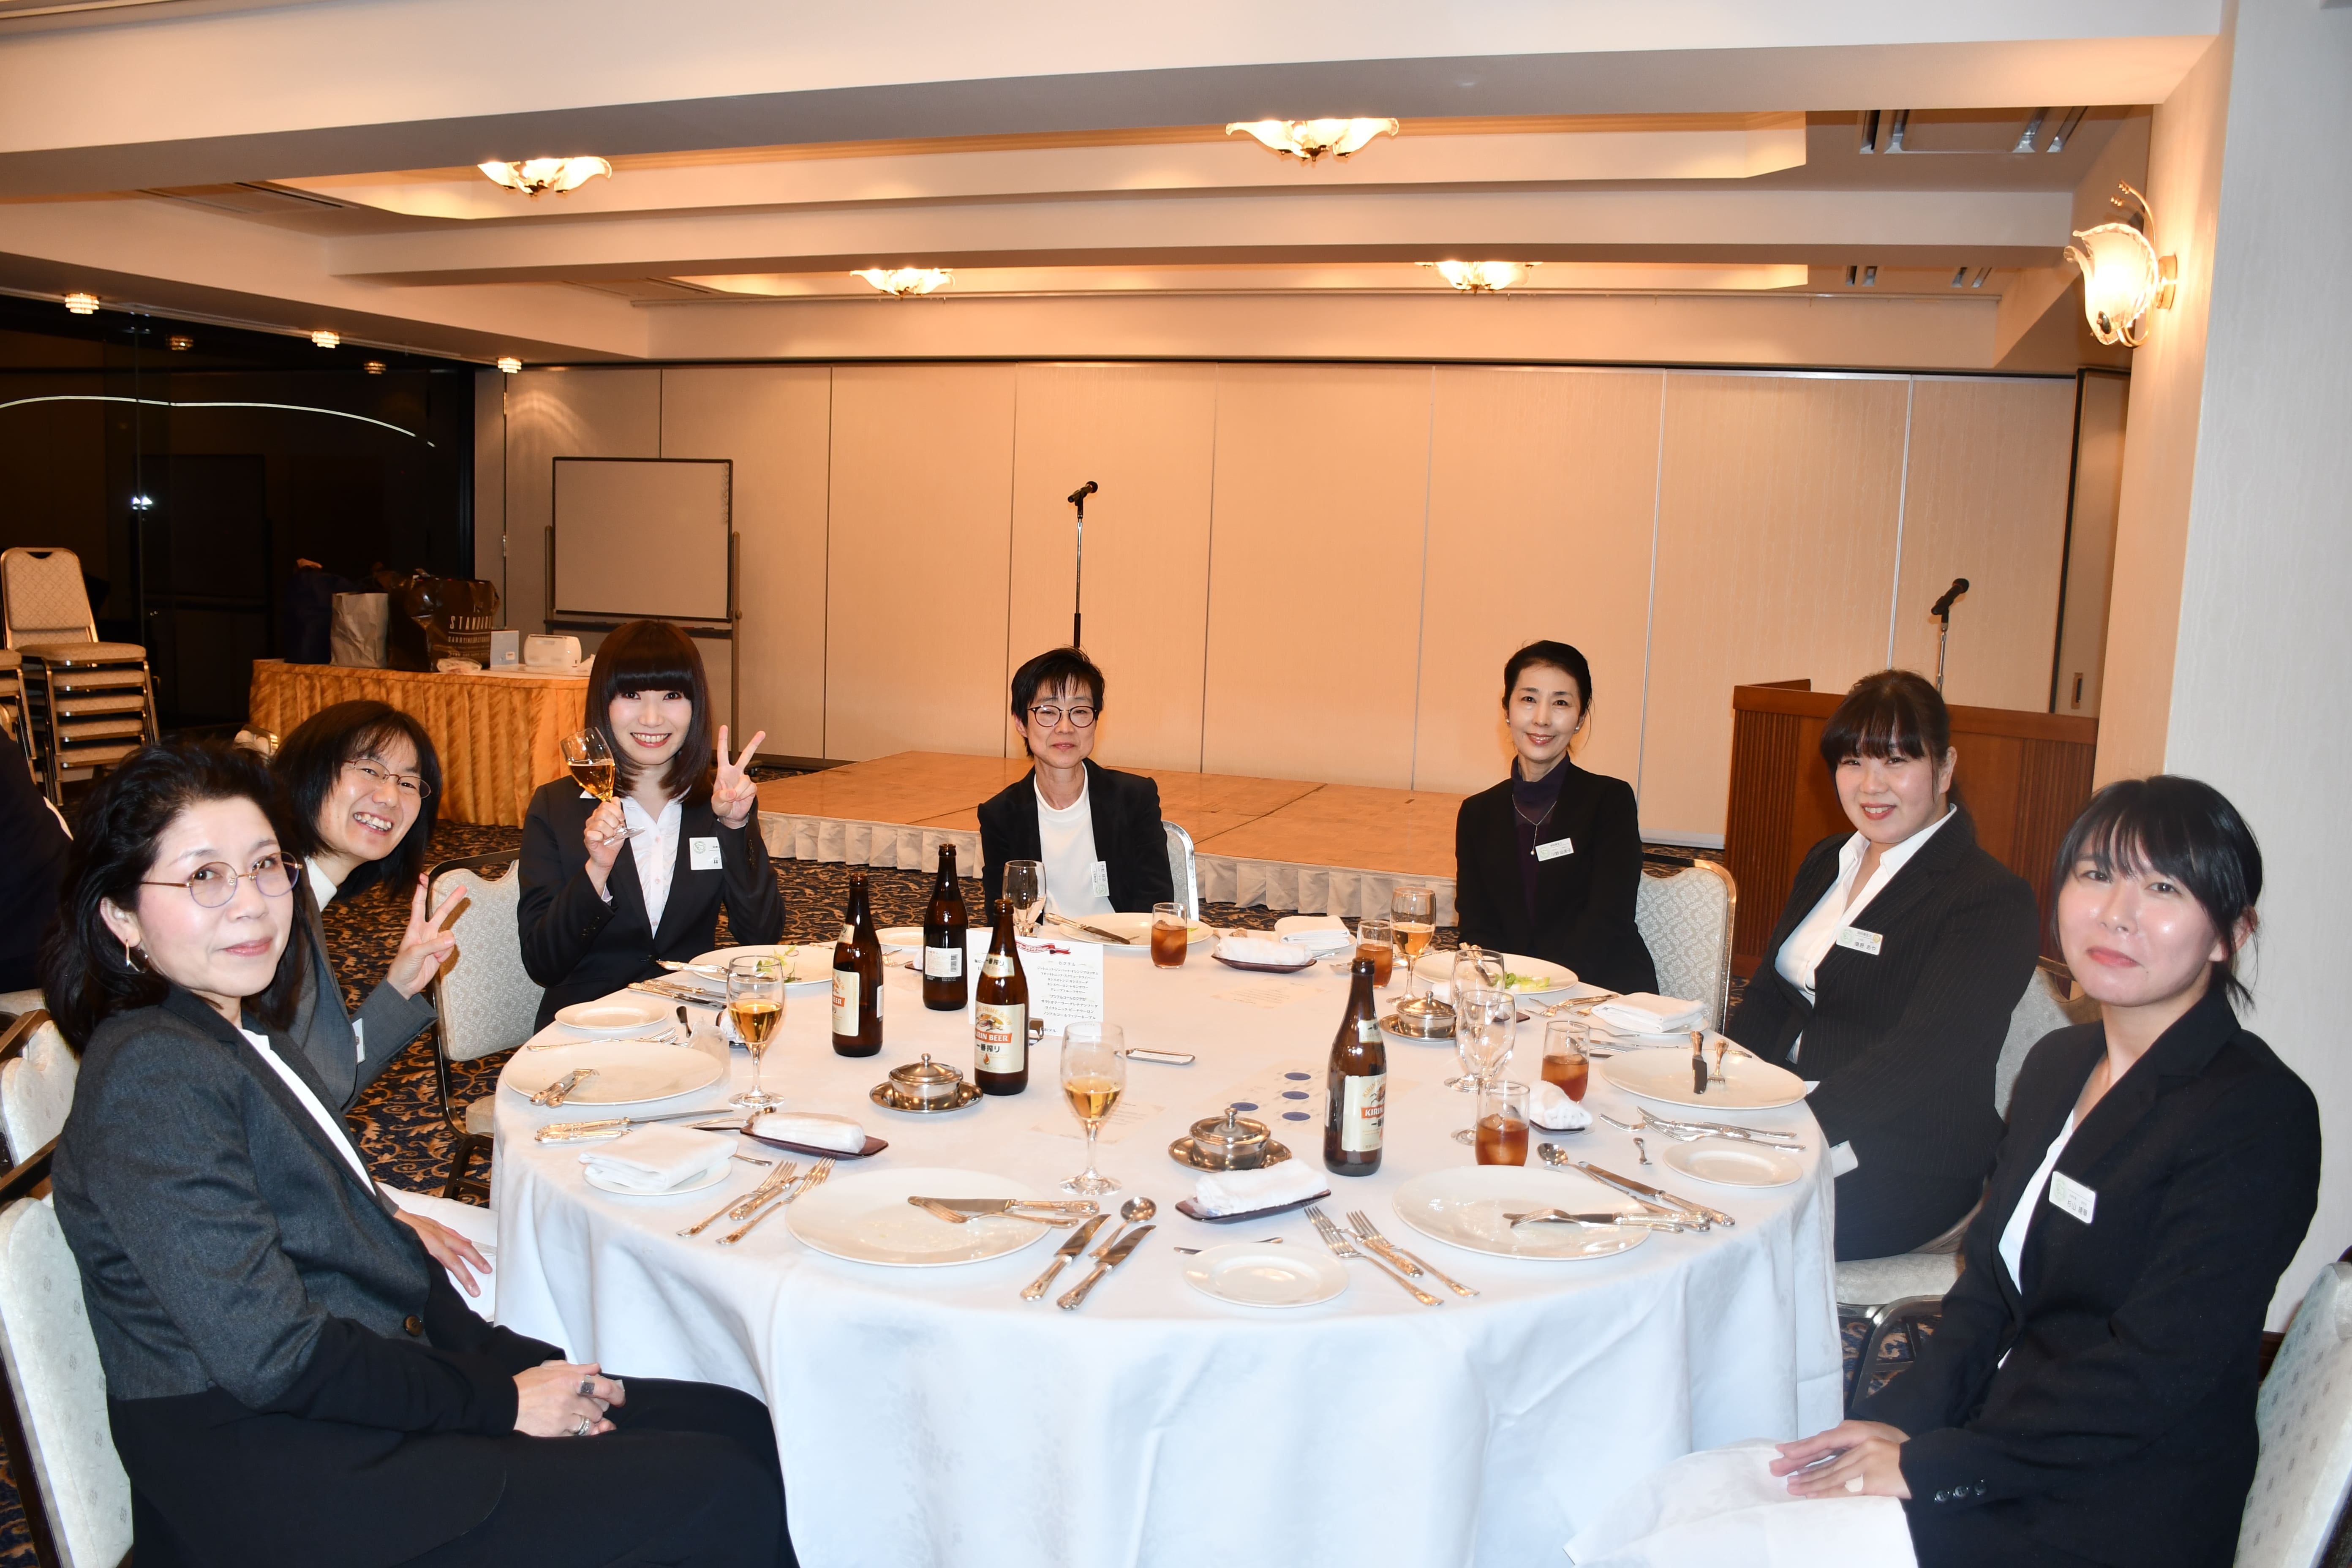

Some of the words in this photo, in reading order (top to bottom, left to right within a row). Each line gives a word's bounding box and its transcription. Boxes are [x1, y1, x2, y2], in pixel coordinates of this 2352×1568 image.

[833, 997, 842, 1005] EER
[976, 1043, 1000, 1053] 一番搾り
[1365, 1107, 1383, 1116] KIRIN
